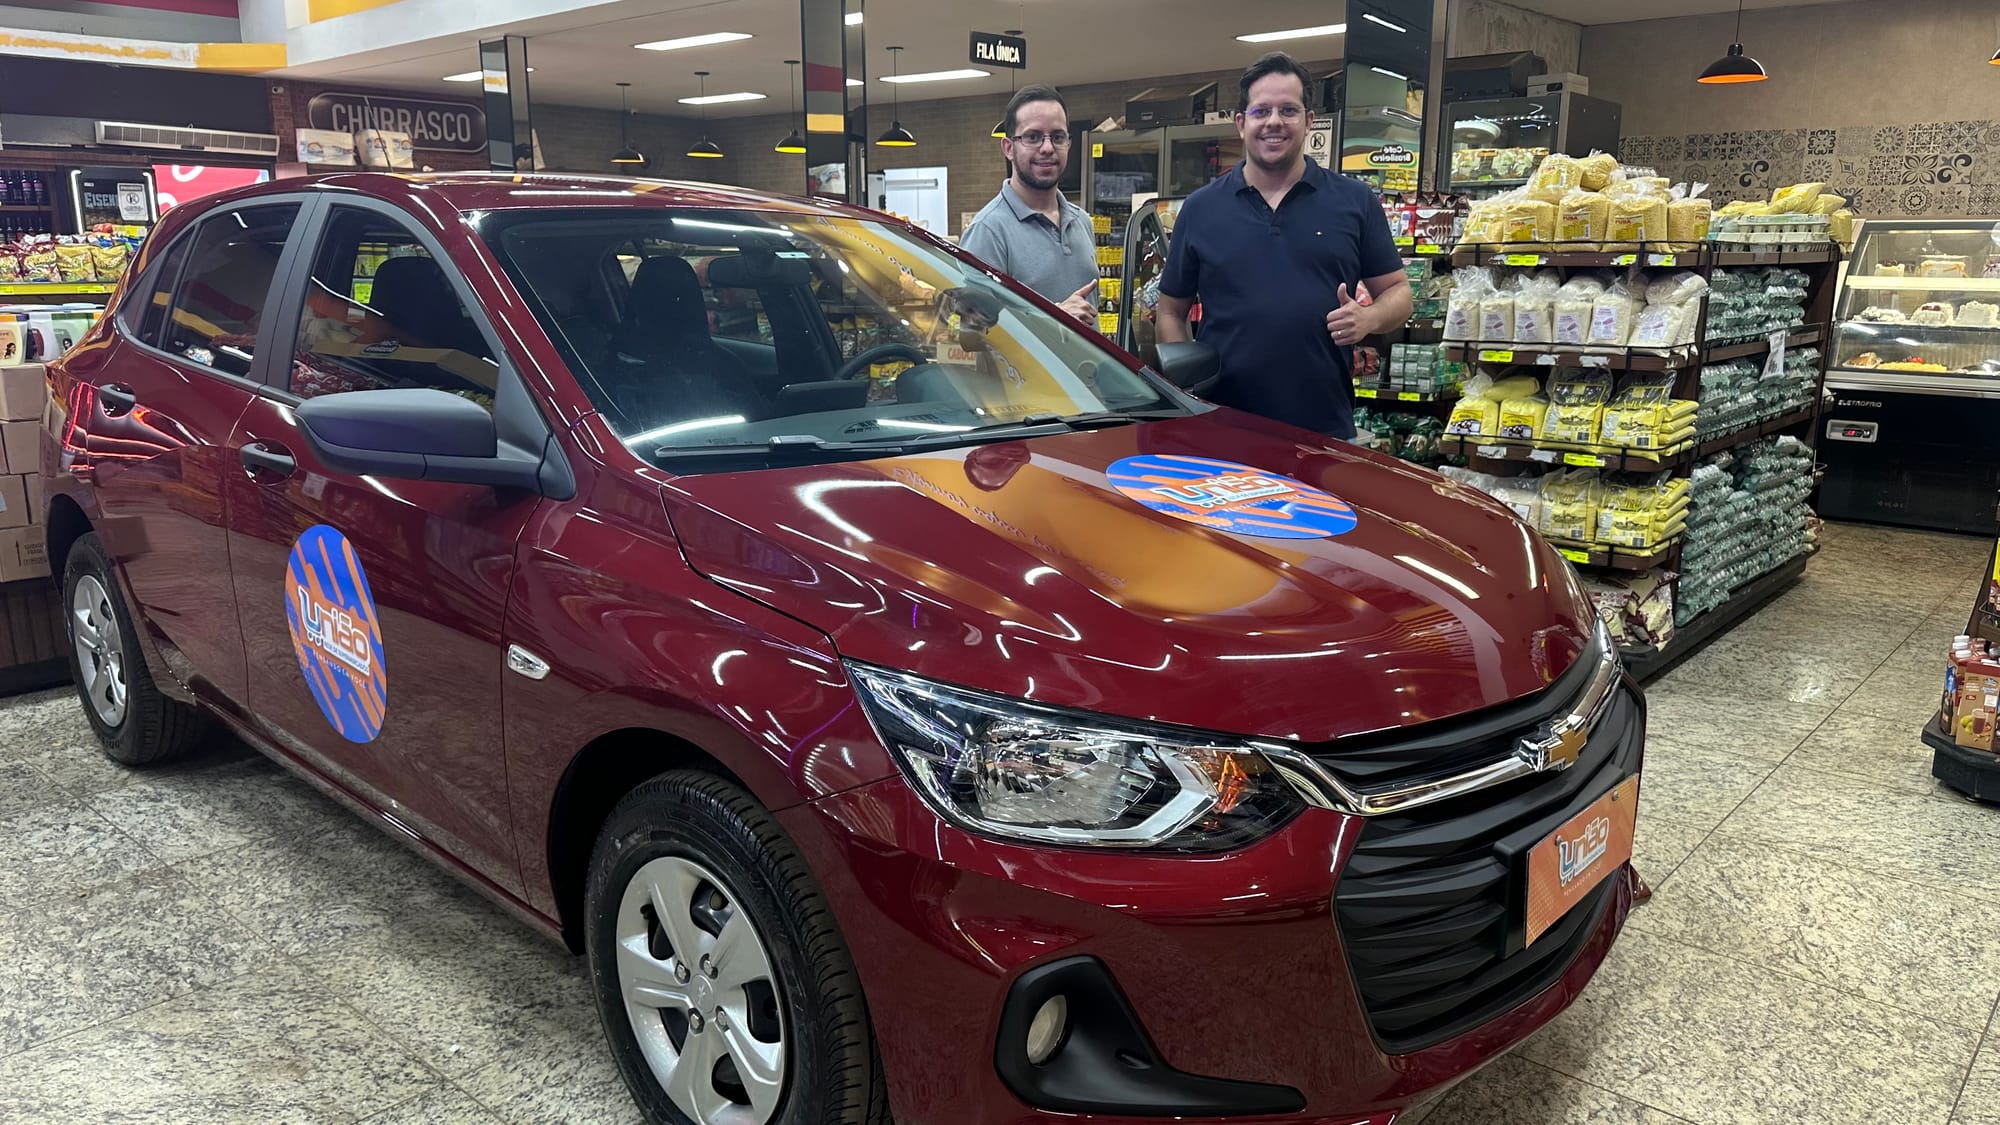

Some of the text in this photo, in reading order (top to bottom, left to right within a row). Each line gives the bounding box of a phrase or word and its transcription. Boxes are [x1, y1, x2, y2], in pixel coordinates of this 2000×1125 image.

[976, 39, 1020, 63] FILA ÚNICA
[331, 103, 471, 143] CHURRASCO
[299, 586, 371, 661] União
